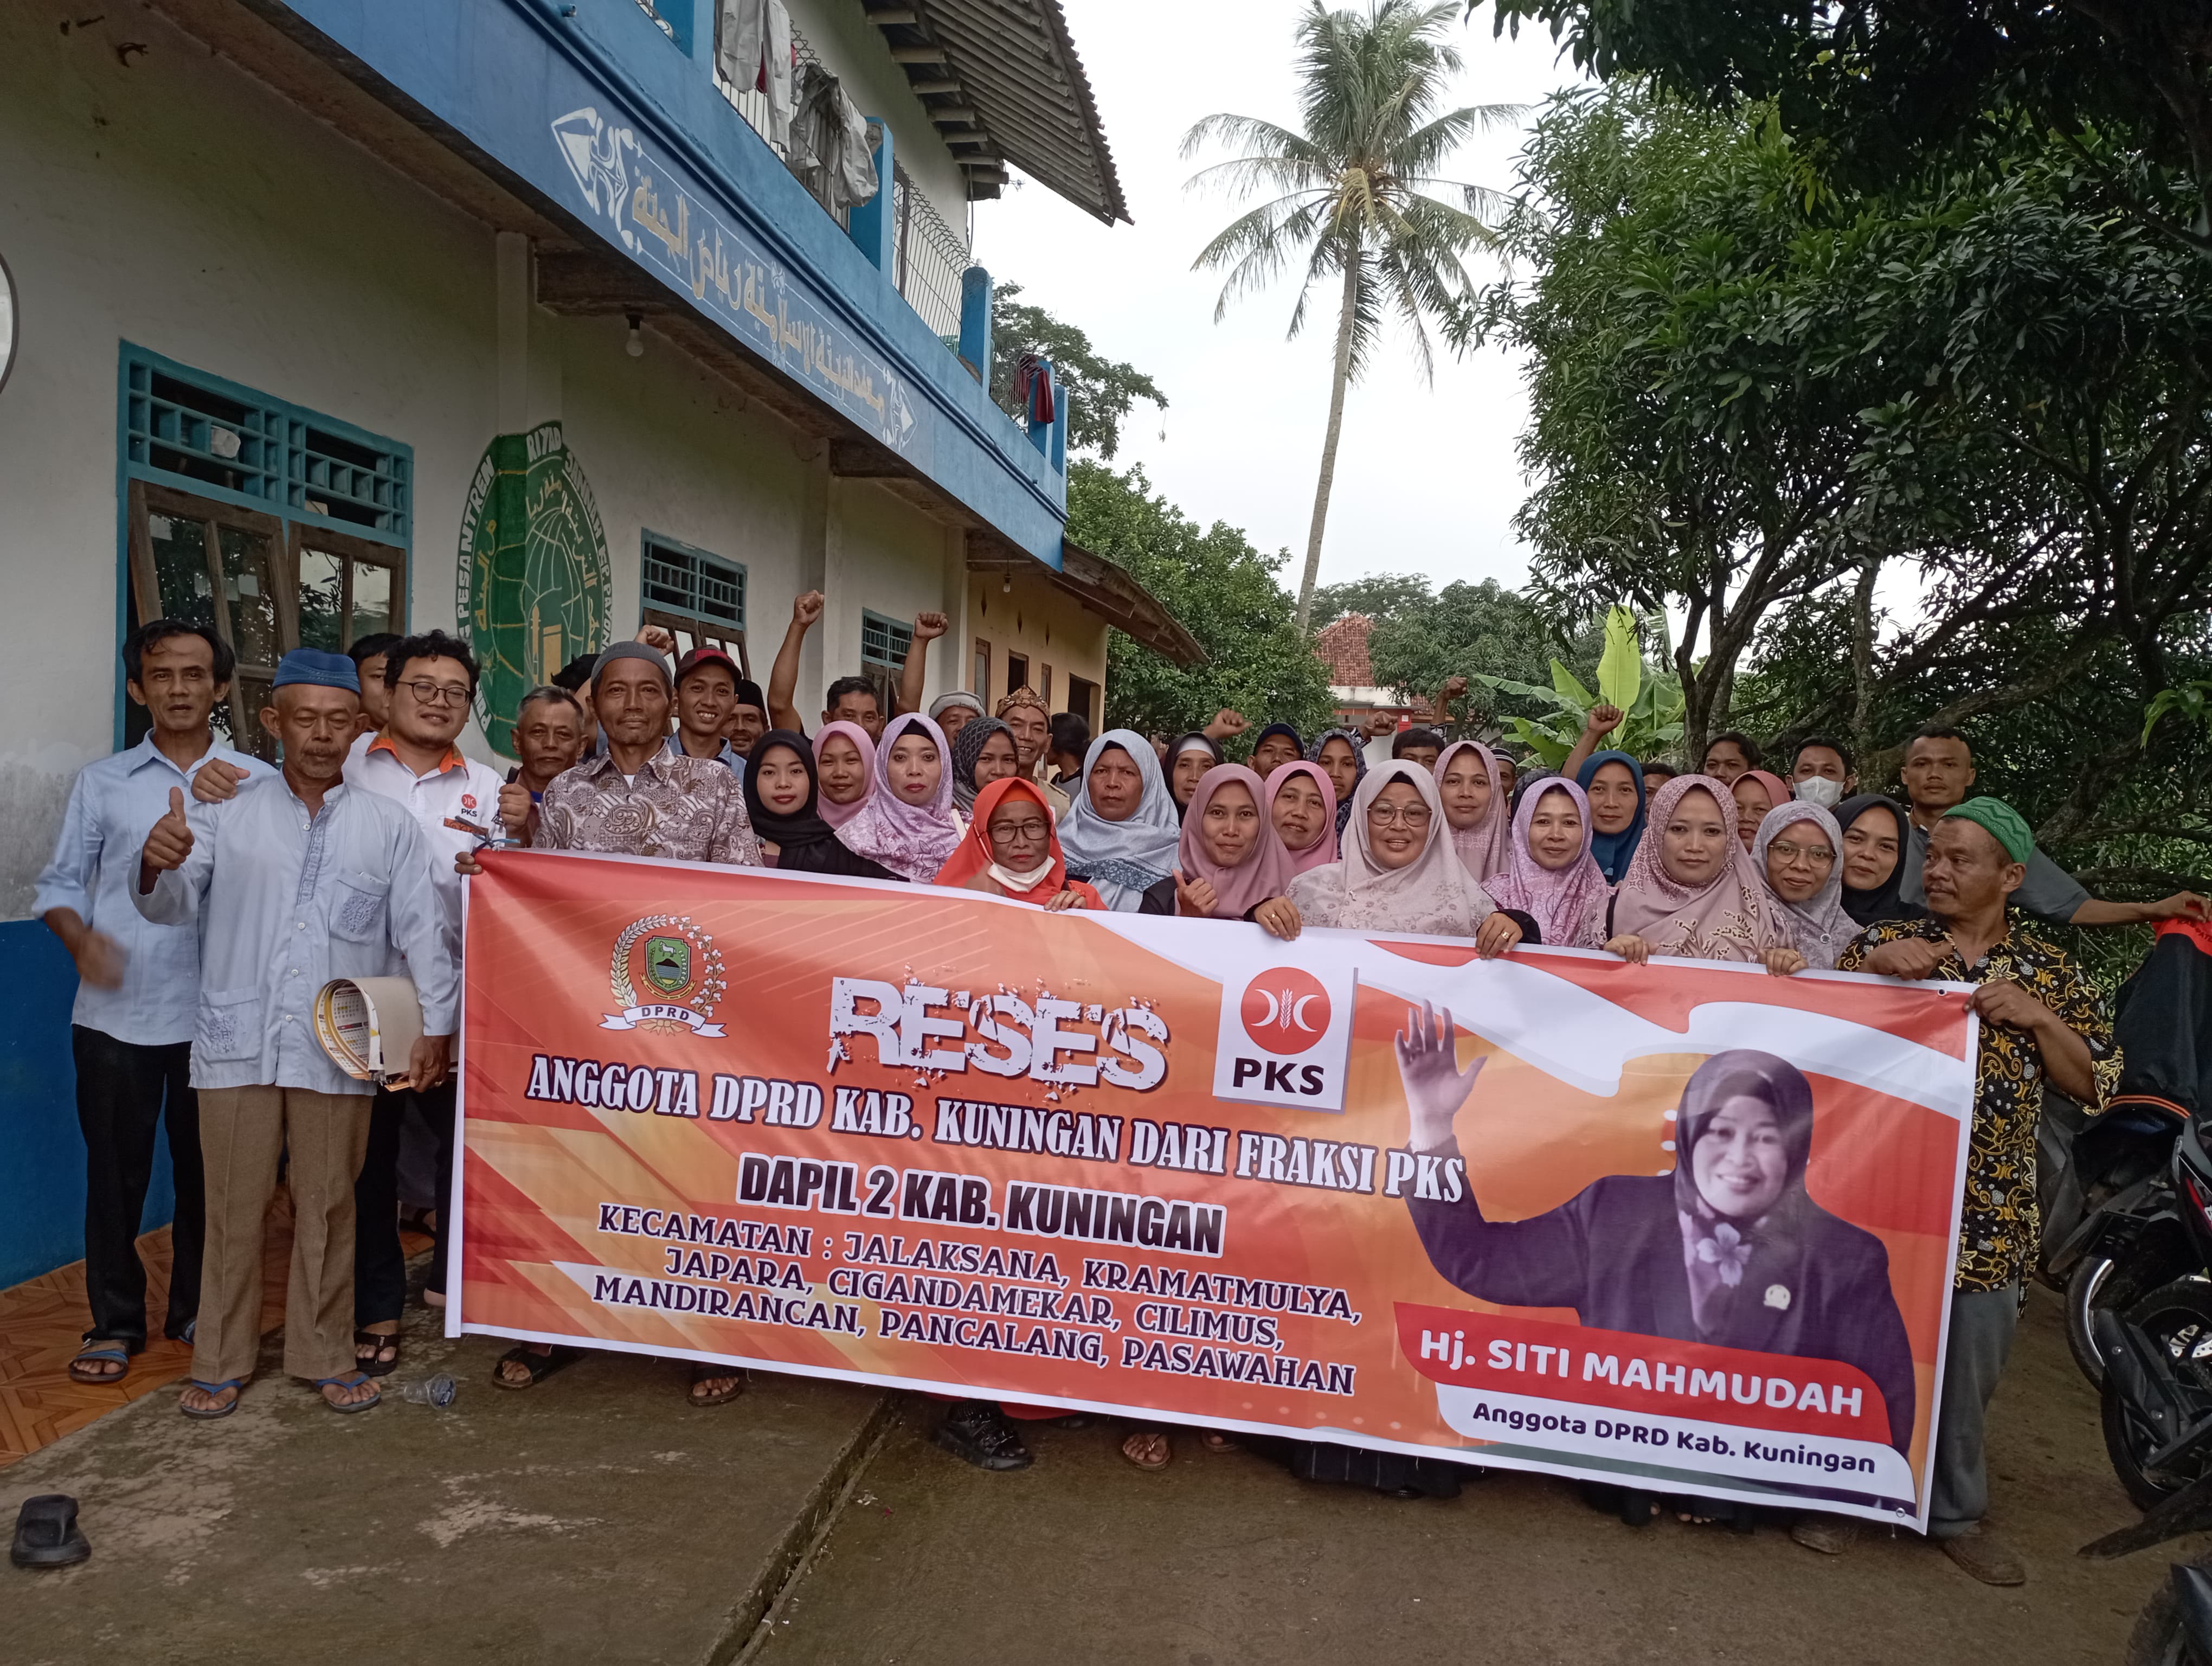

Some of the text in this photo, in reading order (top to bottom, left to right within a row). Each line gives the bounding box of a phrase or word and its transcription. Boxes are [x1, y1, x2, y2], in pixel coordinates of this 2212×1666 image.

[457, 454, 496, 619] PESANTREN
[461, 808, 477, 817] PKS
[641, 1006, 690, 1021] DPRD
[827, 975, 1169, 1093] RESES
[1232, 1057, 1324, 1095] PKS
[526, 1055, 1465, 1203] ANGGOTA DPRD KAB. KUNINGAN DARI FRAKSI PKS
[740, 1156, 1224, 1254] DAPIL 2 KAB. KUNINGAN
[599, 1204, 812, 1256] KECAMATAN
[844, 1233, 1069, 1287] JALAKSANA,
[1082, 1260, 1361, 1324] KRAMATMULYA,
[665, 1247, 1283, 1352] JAPARA, CIGANDAMEKAR, CILIMUS,
[879, 1310, 1108, 1368] PANCALANG,
[1121, 1338, 1356, 1395] PASAWAHAN
[1420, 1329, 1863, 1418] Hj. SITI MAHMUDAH
[1472, 1402, 1875, 1474] Anggota DPRD Kab. Kuningan
